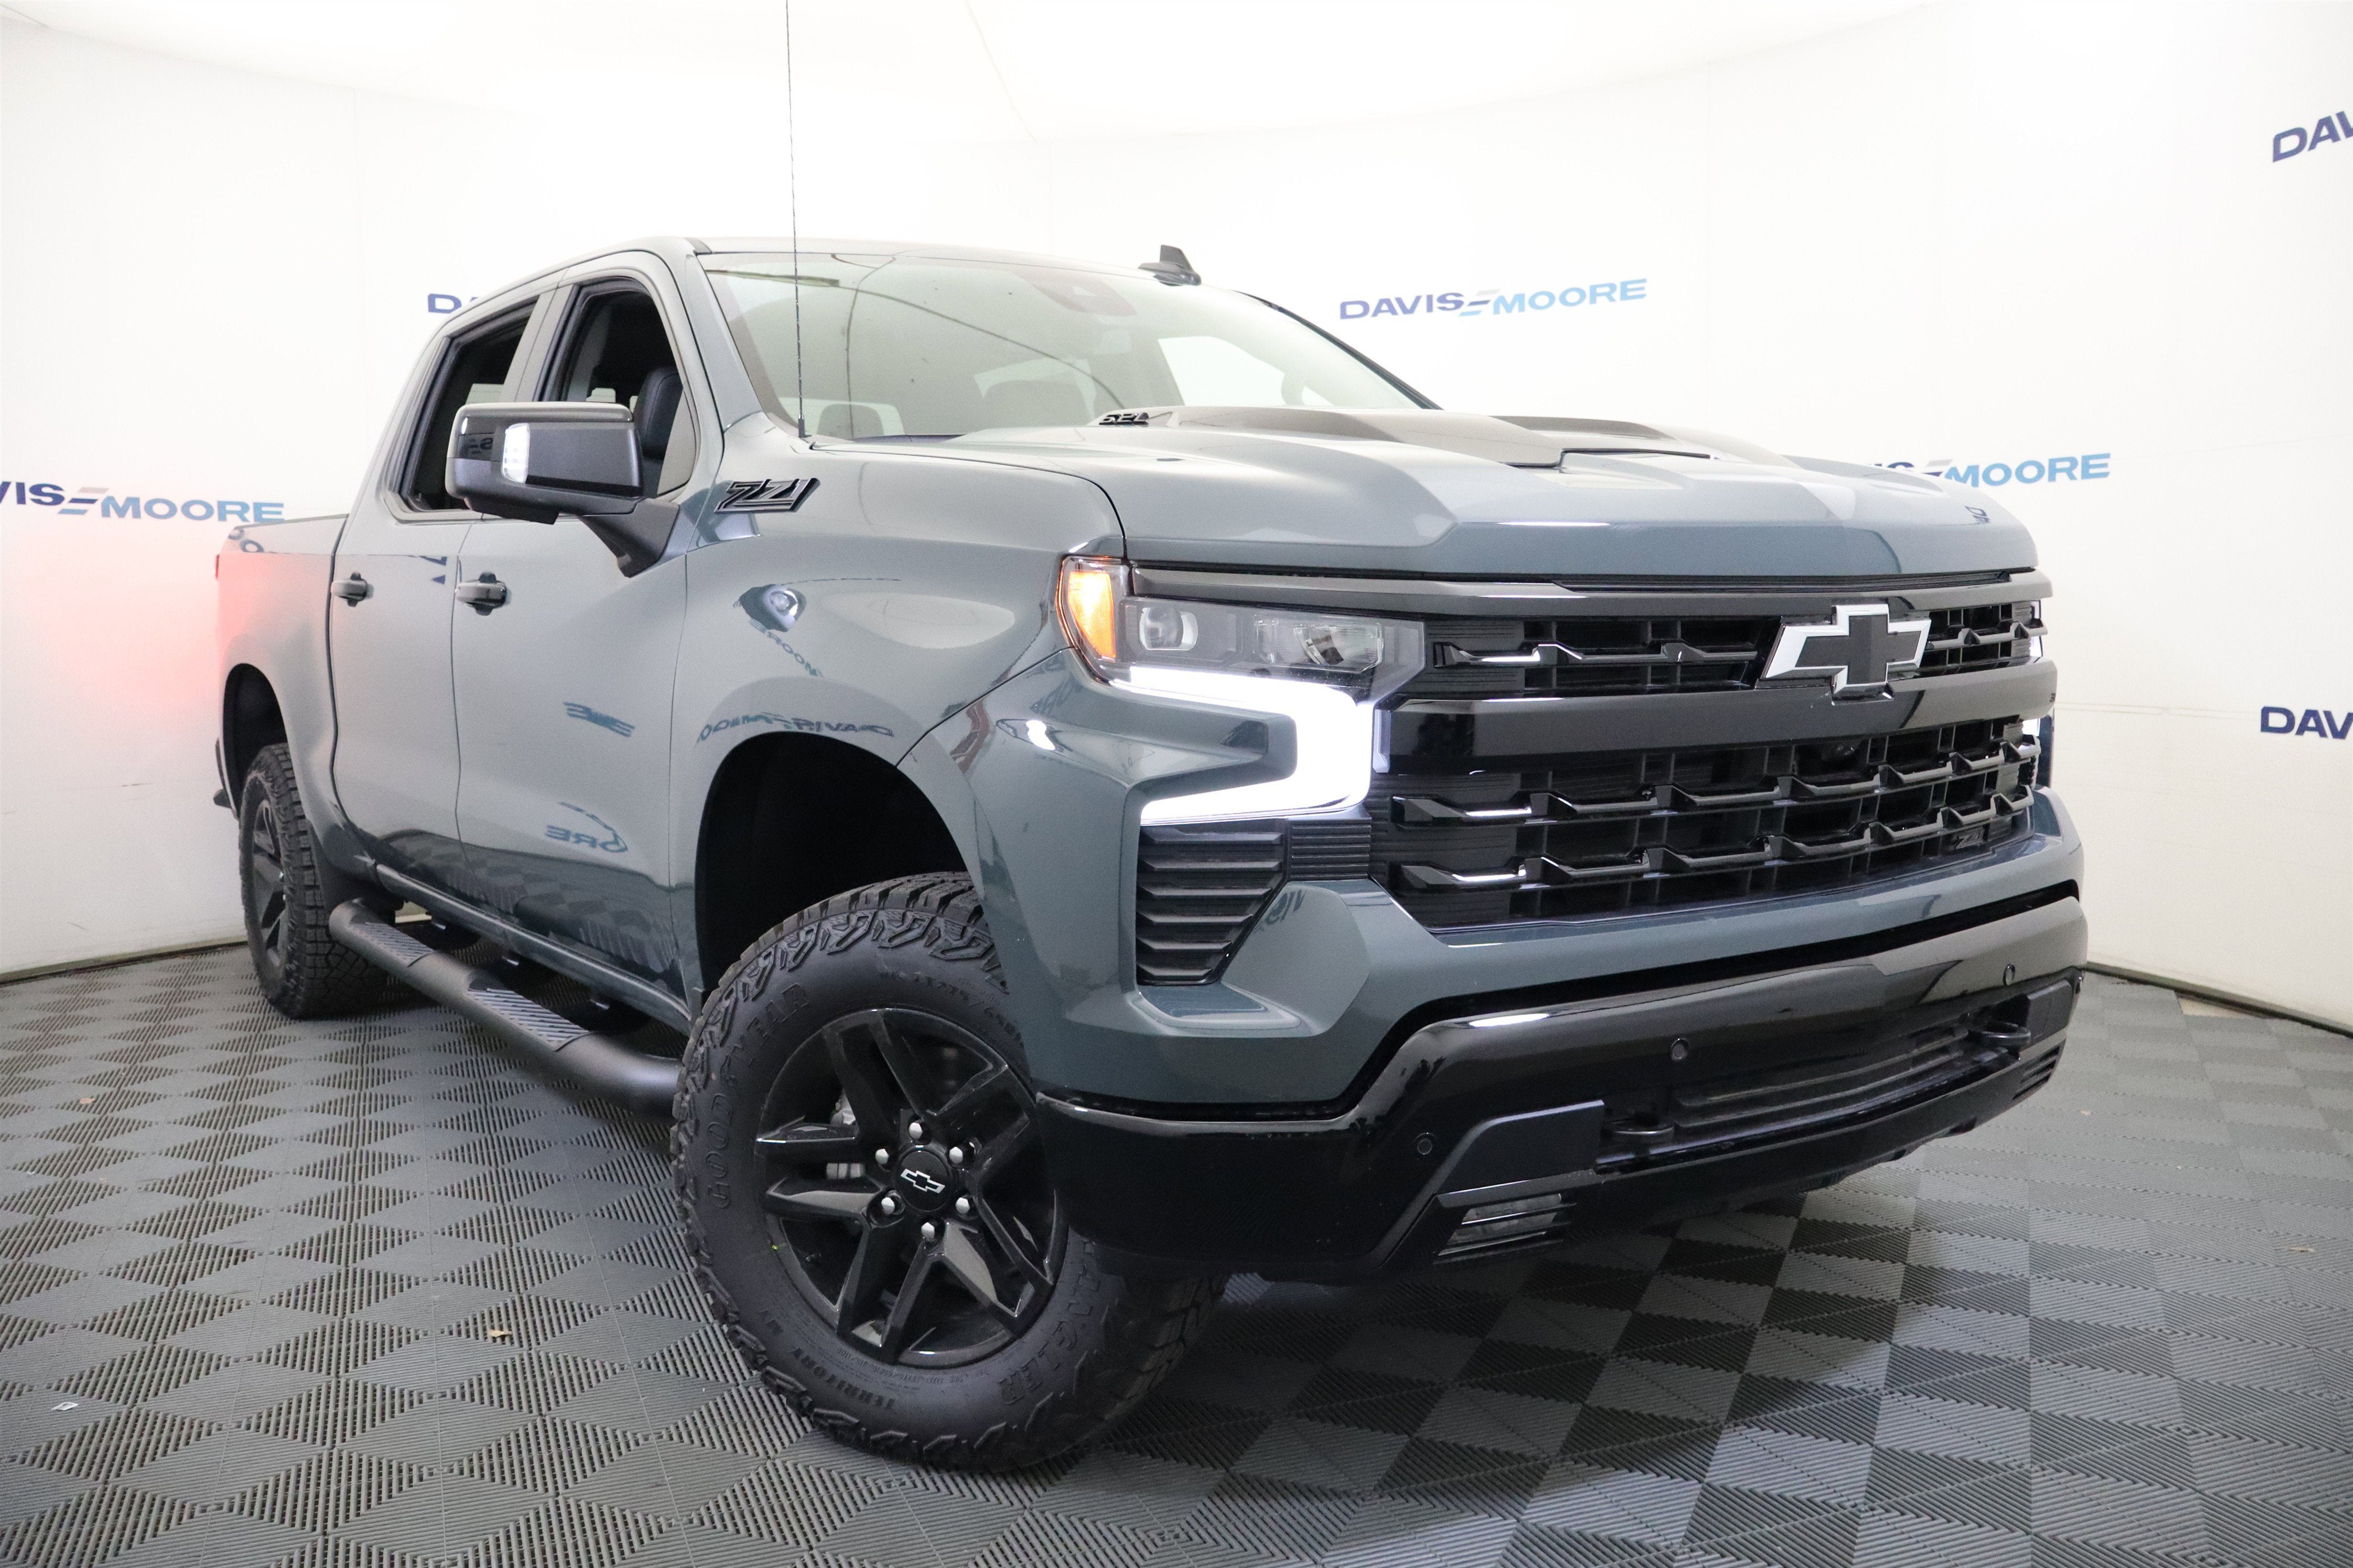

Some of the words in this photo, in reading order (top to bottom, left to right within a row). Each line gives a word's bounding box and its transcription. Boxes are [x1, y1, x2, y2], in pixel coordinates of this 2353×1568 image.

[1339, 292, 1465, 320] DAVIS
[1492, 278, 1648, 315] MOORE
[1945, 453, 2111, 487] MOORE
[102, 496, 286, 523] MOORE
[714, 477, 820, 513] Z71
[2261, 706, 2353, 740] DAV
[790, 1347, 894, 1409] TERRITORY
